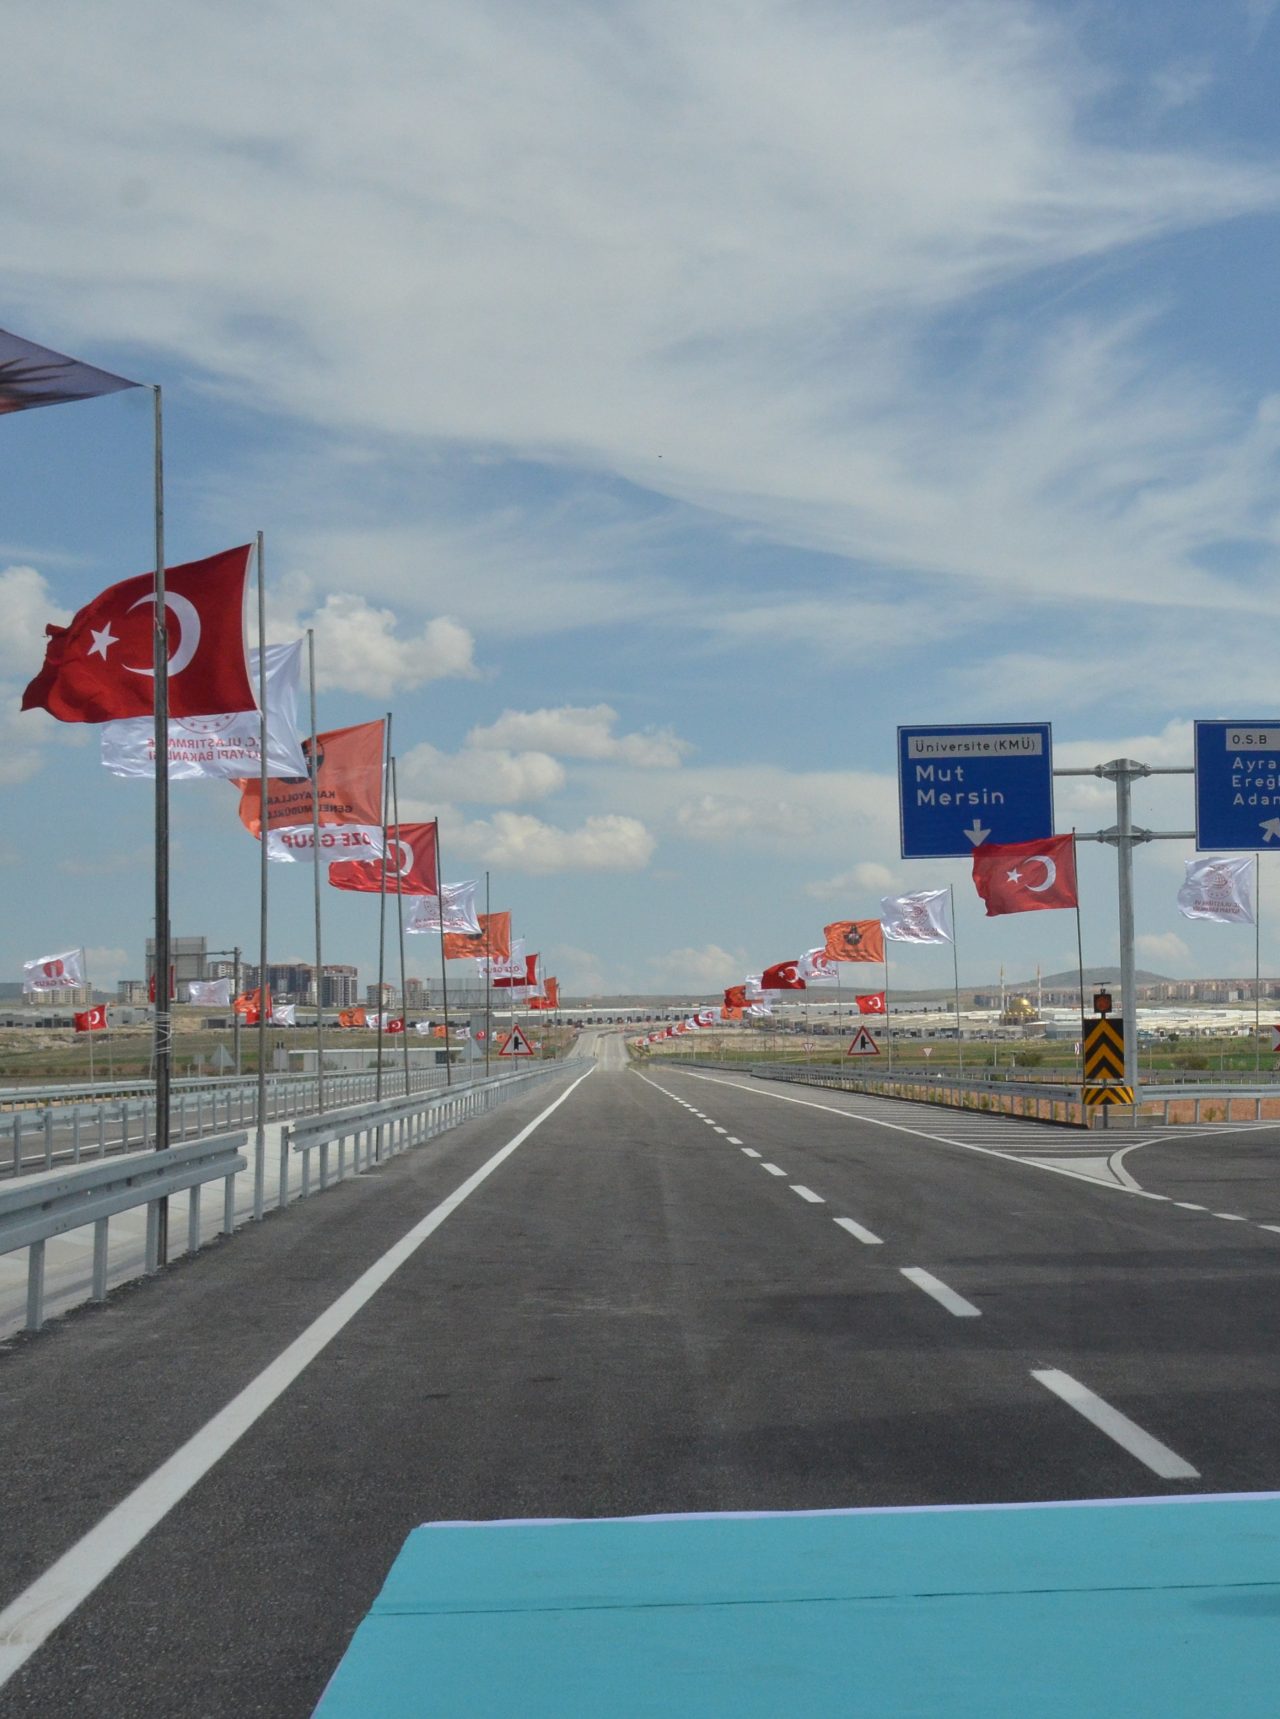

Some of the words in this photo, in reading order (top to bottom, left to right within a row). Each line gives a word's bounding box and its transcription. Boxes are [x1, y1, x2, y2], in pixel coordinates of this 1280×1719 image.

[915, 740, 990, 752] Üniversite
[993, 737, 1035, 752] (KMÜ)
[1232, 734, 1267, 745] O.S.B
[916, 765, 964, 782] Mut
[917, 788, 1005, 806] Mersin
